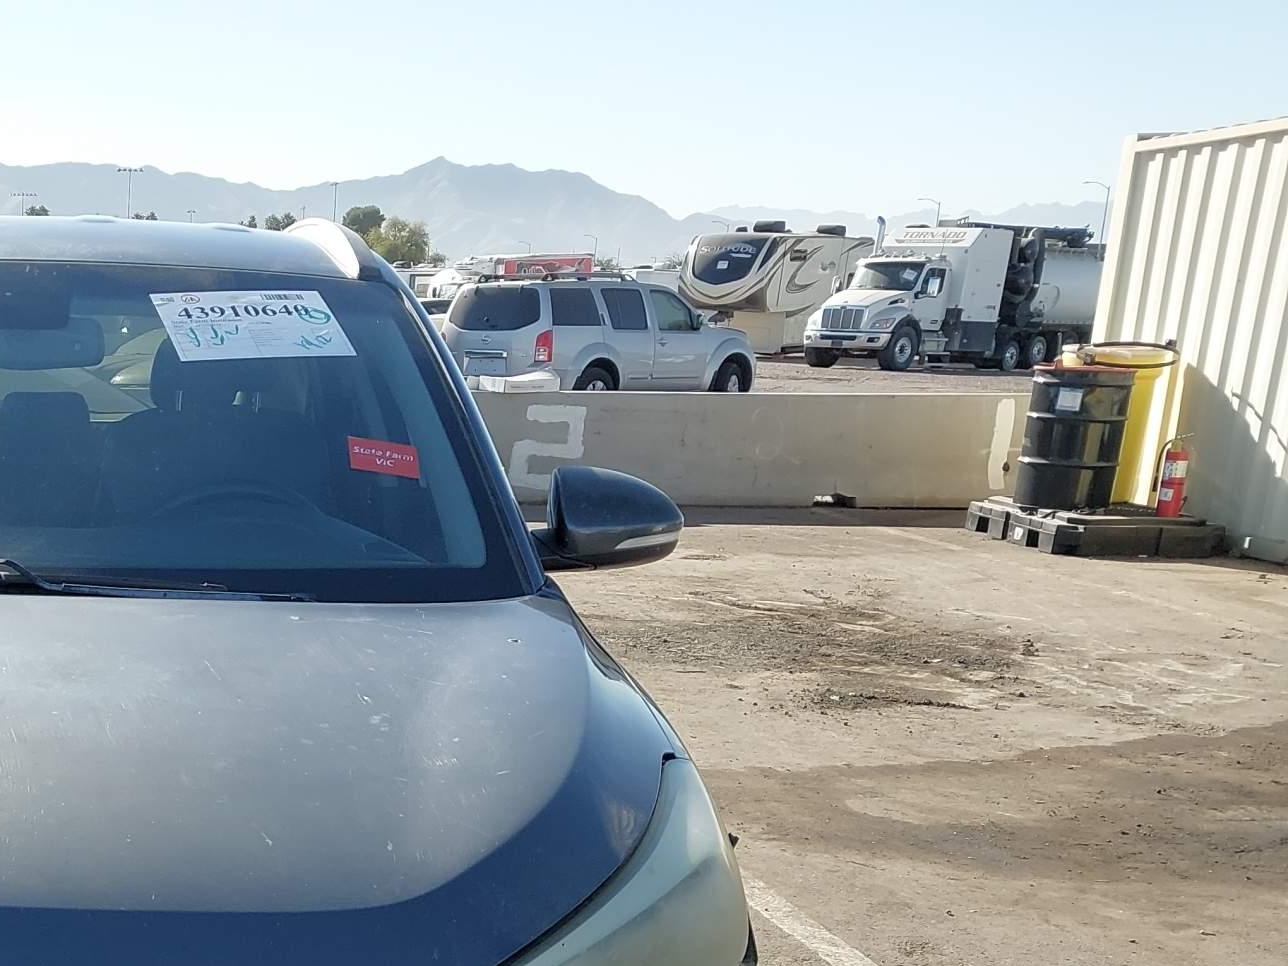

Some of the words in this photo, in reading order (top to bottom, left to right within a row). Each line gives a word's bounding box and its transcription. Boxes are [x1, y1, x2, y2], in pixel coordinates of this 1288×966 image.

[903, 231, 968, 239] TORNADO
[177, 304, 310, 319] 43910640
[353, 445, 383, 457] State
[385, 450, 414, 462] Farm
[509, 404, 588, 490] 2
